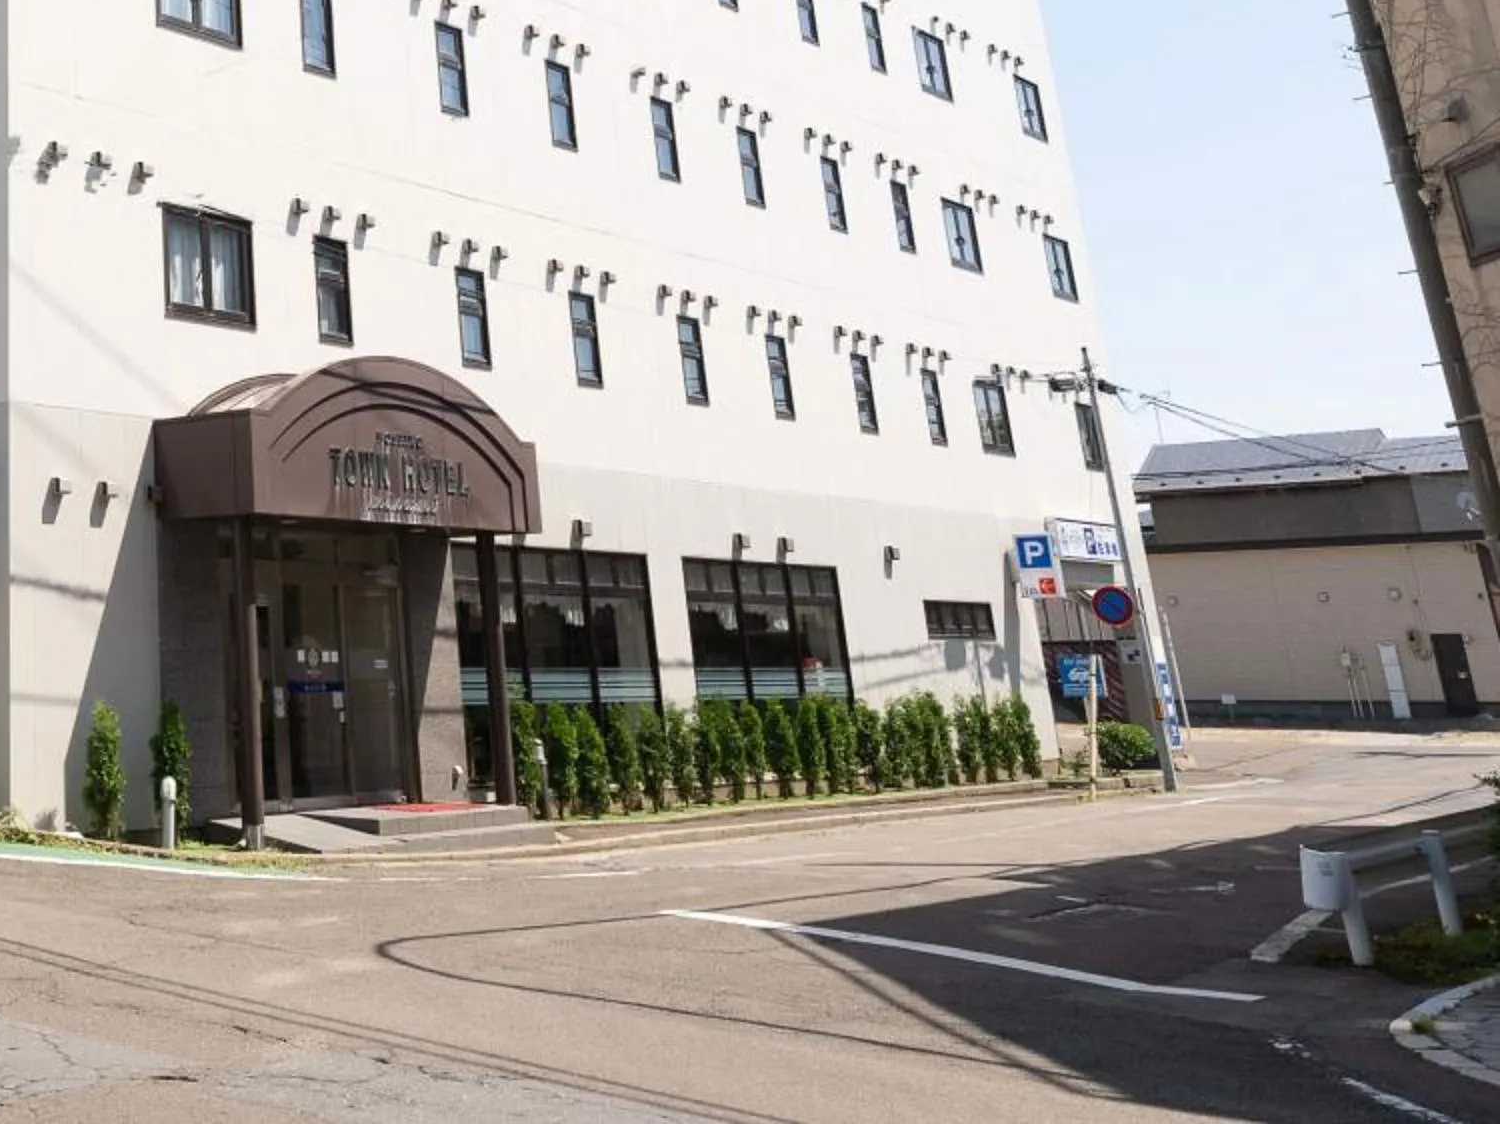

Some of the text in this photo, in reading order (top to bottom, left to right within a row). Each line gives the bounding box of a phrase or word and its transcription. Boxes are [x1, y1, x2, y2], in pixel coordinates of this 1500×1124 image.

[328, 446, 470, 498] TOWN HOTEL
[1023, 540, 1046, 566] P
